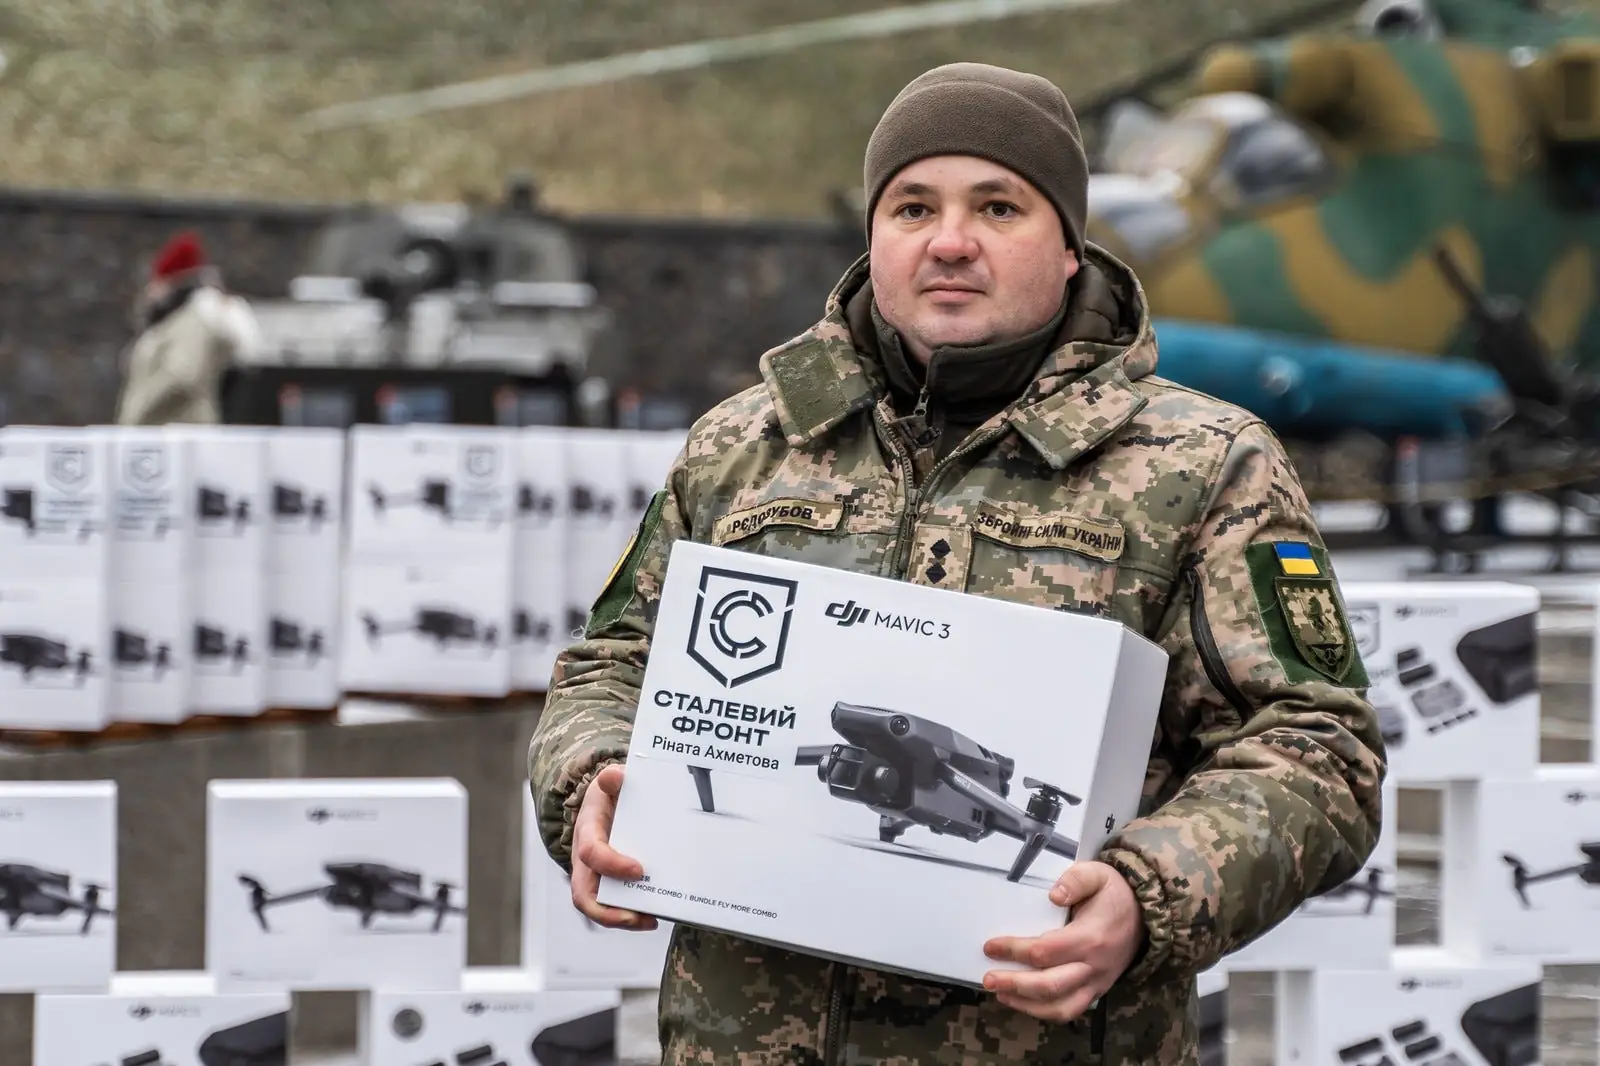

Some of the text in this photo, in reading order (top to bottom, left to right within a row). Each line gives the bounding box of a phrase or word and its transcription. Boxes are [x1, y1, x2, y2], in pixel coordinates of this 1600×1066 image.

[977, 512, 1122, 550] ЗБРОЙНІ СИЛИ УКРАЇНИ
[874, 611, 935, 636] MAVIC
[938, 623, 951, 639] 3
[654, 690, 796, 729] СТАЛЕВИЙ
[671, 716, 770, 746] ФРОНТ
[652, 735, 780, 770] Ріната Ахметова
[623, 880, 636, 889] FLY
[636, 883, 656, 893] MORE
[657, 888, 683, 899] COMBO
[689, 895, 717, 906] BUNDLE
[718, 901, 730, 909] FLY
[731, 903, 751, 913] MORE
[752, 908, 778, 919] COMBO
